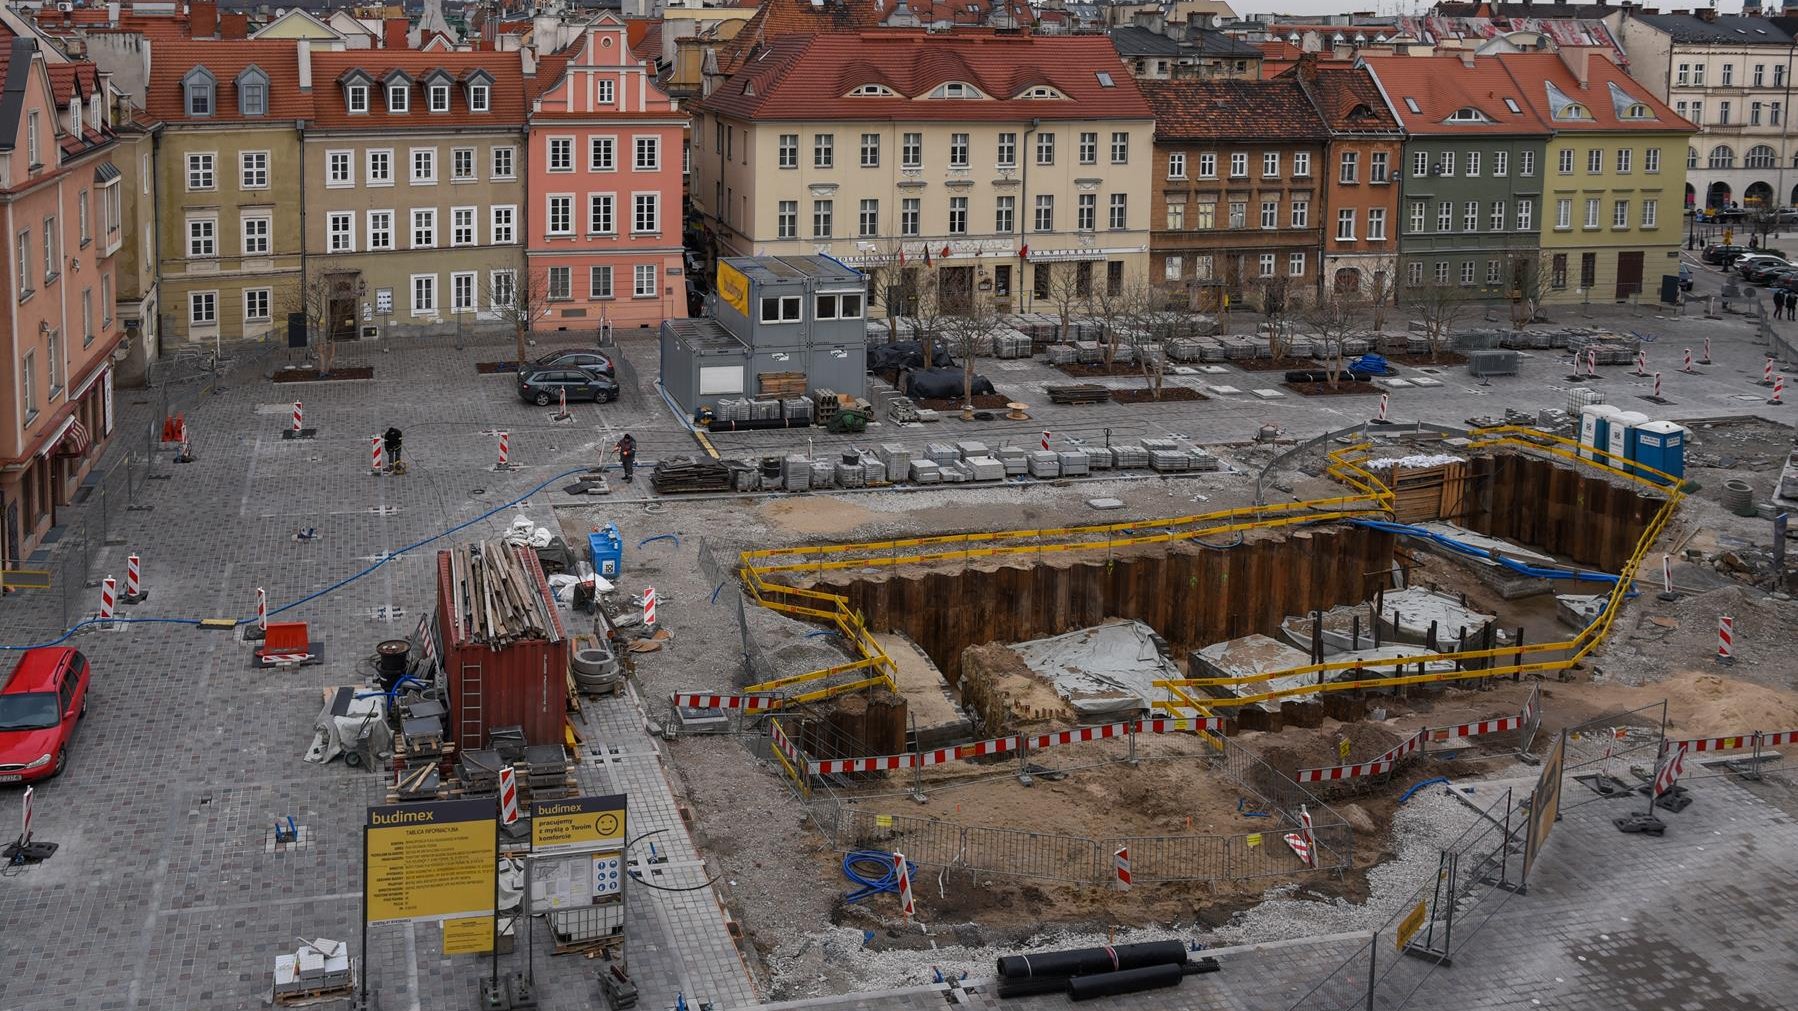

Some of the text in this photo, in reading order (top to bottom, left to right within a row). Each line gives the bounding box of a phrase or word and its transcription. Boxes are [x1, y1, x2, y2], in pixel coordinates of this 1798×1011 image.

[538, 804, 582, 815] budimex
[372, 810, 433, 825] budimex
[539, 819, 573, 827] pracujemy
[539, 834, 571, 842] komforcie
